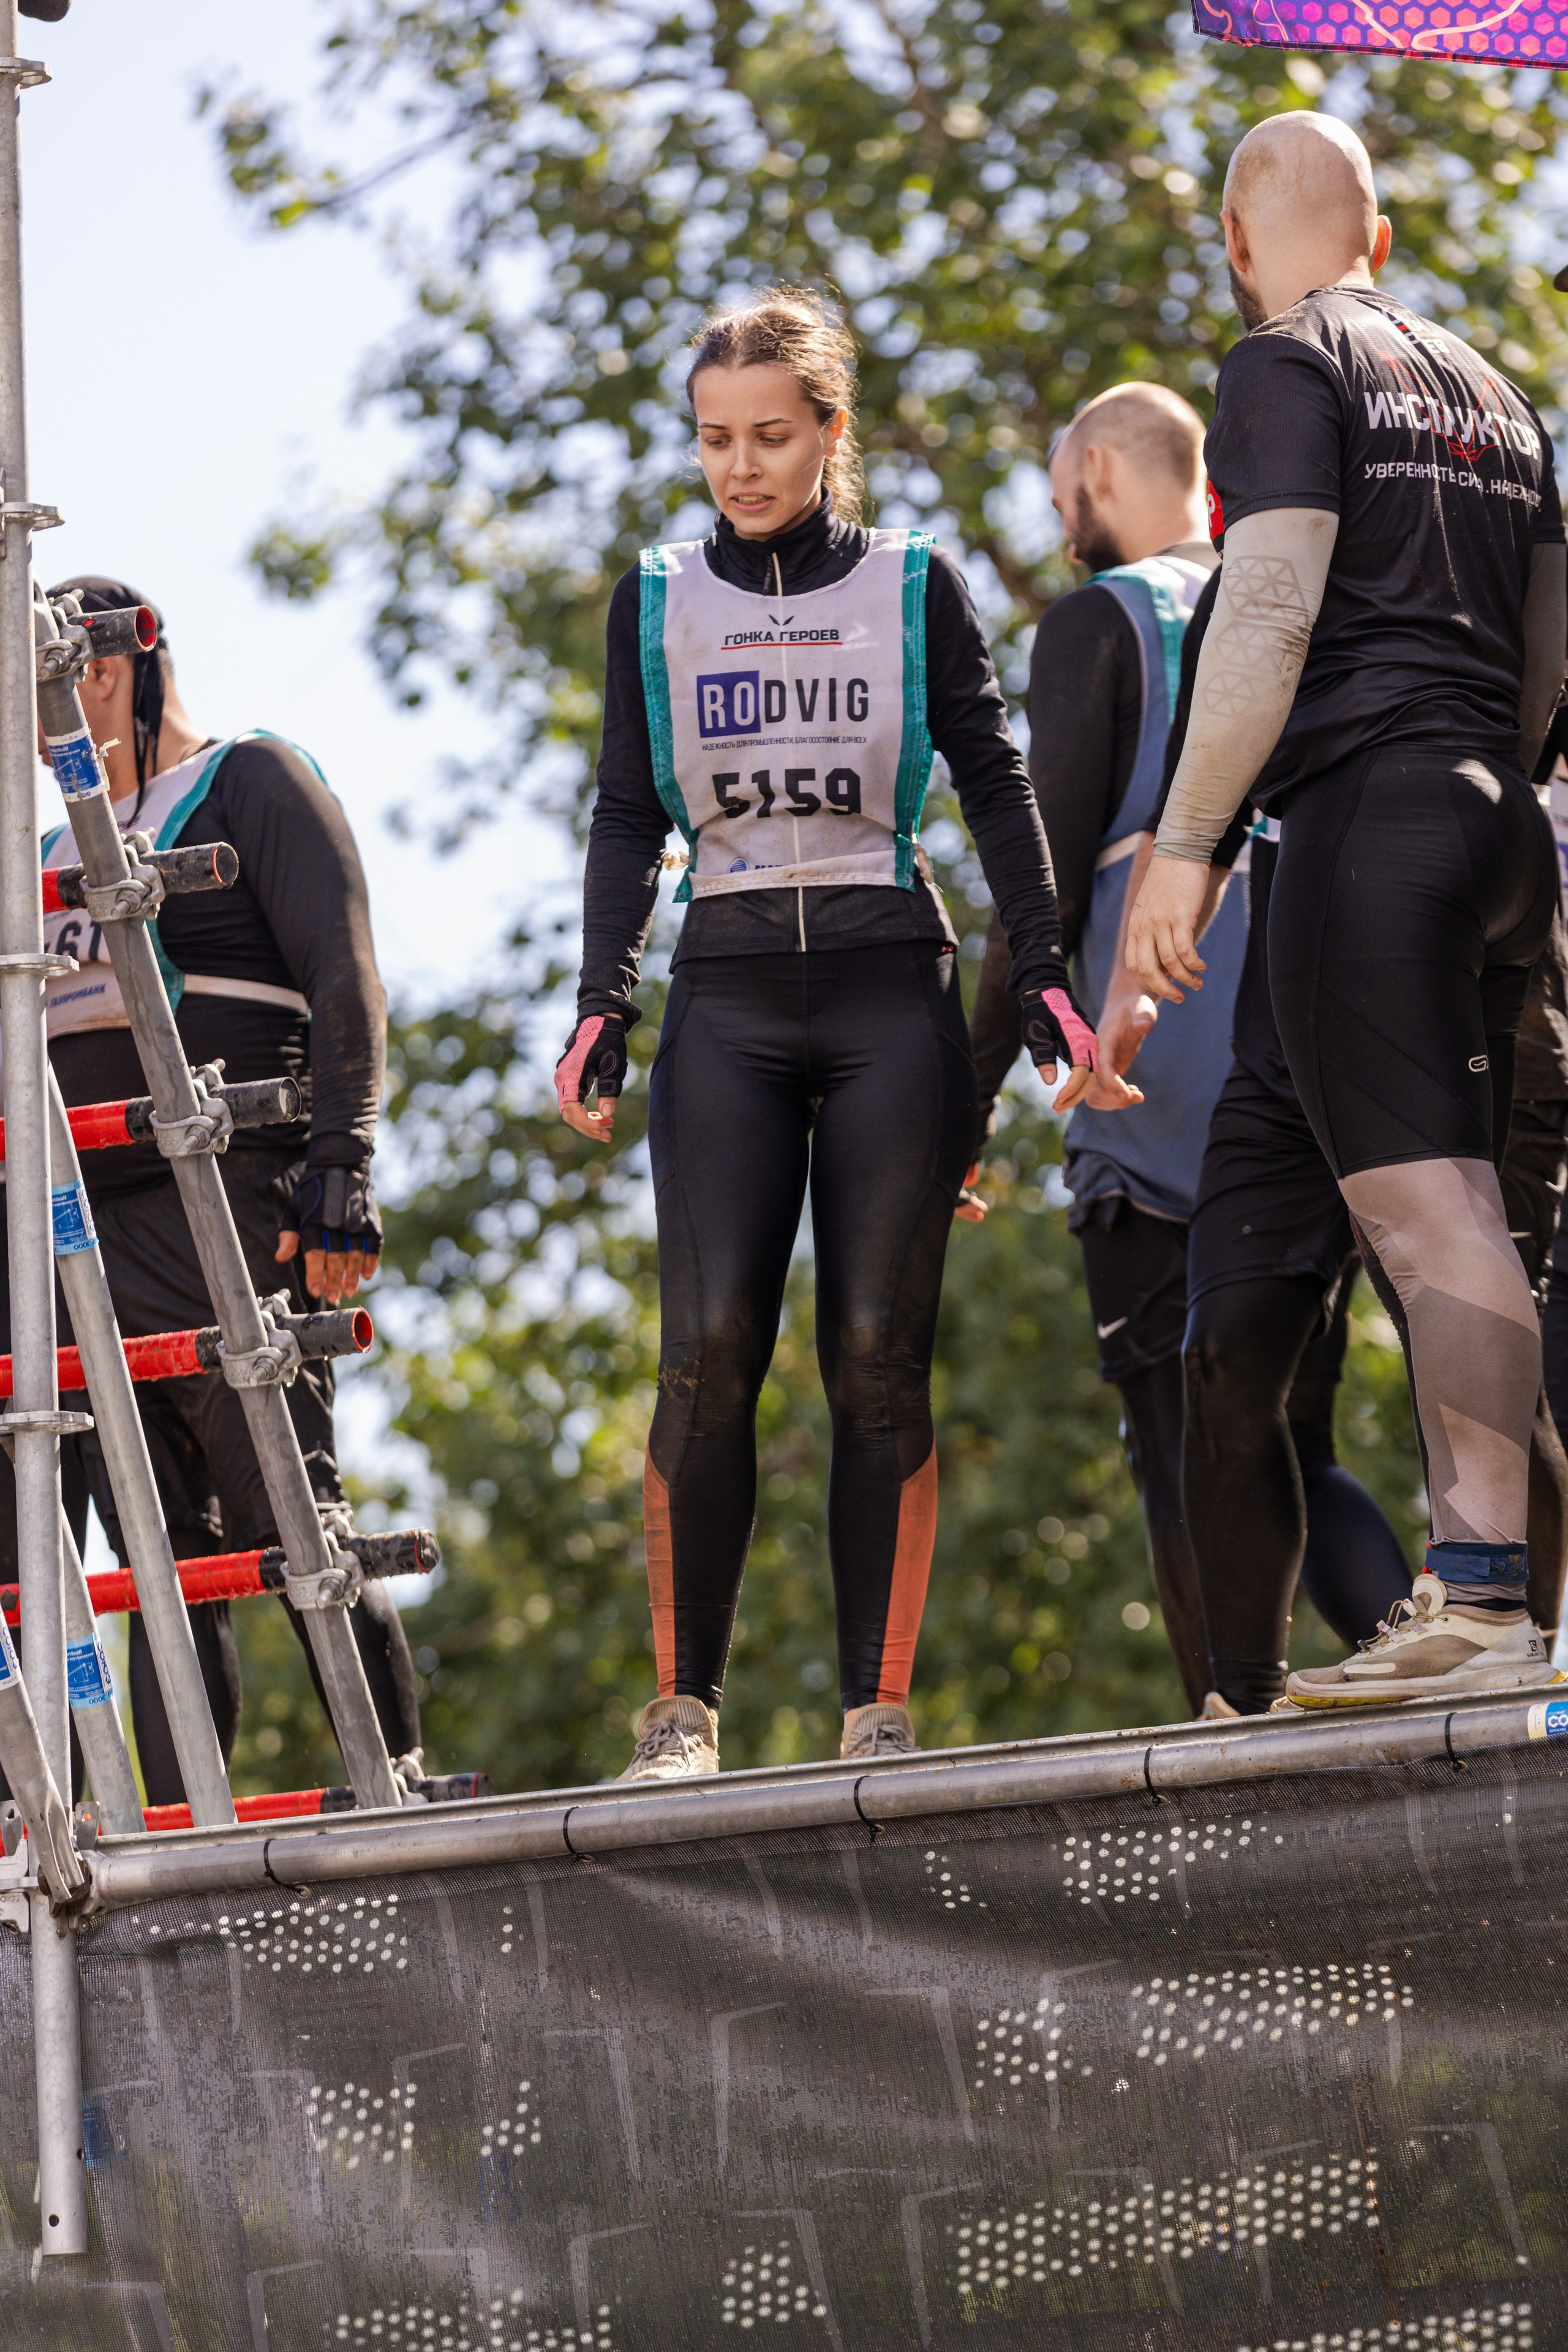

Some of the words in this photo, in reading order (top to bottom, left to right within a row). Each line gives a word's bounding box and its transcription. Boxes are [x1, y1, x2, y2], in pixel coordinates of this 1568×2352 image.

[725, 630, 774, 646] ГОНКА
[780, 629, 840, 642] ГЕРОЕВ
[702, 677, 869, 729] RODVIG
[702, 741, 736, 752] НАДЕЖНОСТЬ
[712, 767, 862, 819] 5159
[44, 919, 102, 960] 61
